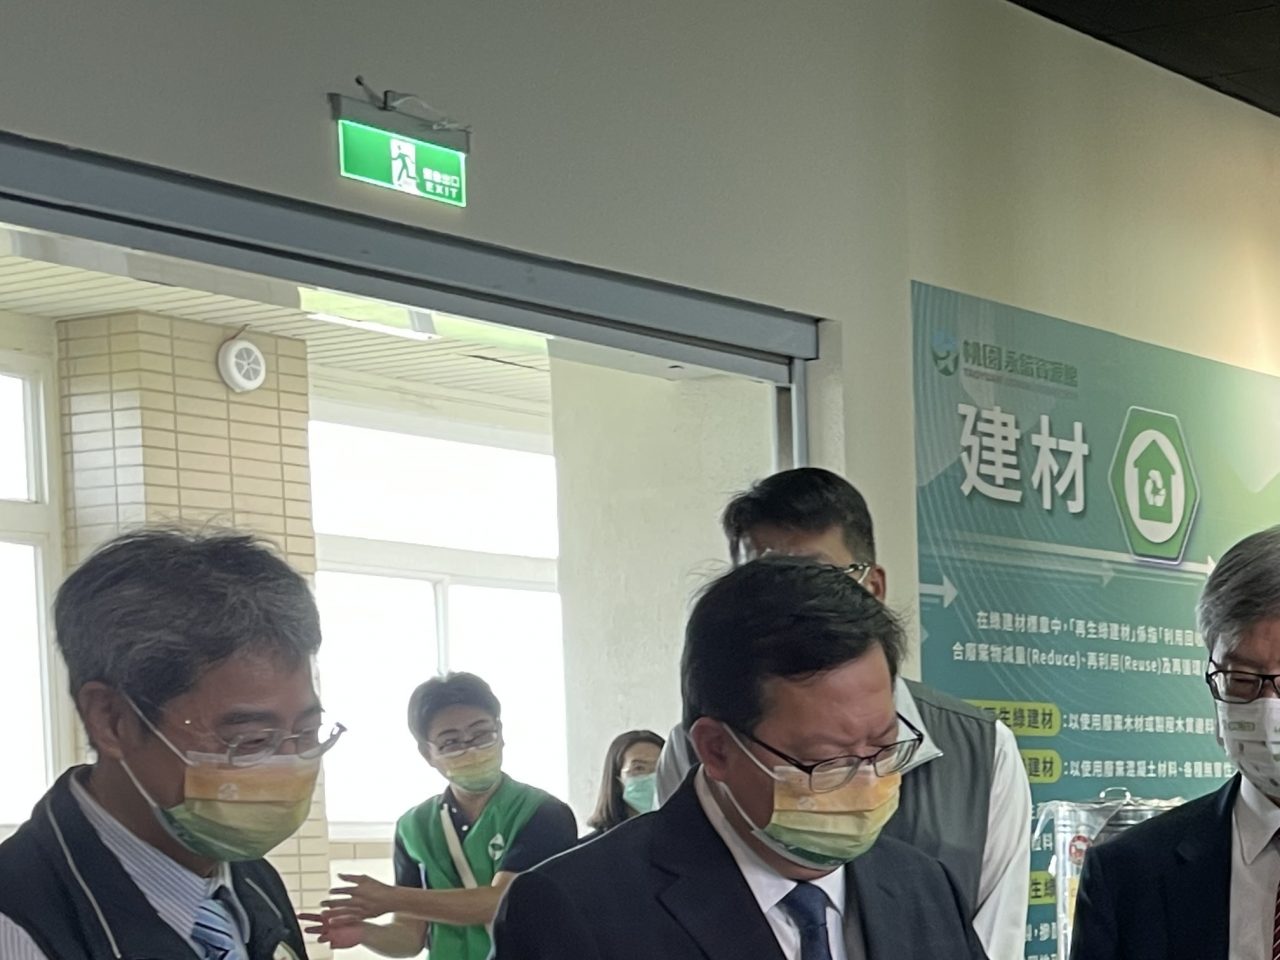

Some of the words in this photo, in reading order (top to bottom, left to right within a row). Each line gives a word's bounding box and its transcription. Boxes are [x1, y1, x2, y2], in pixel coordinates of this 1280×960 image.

[425, 180, 458, 199] EXIT
[957, 402, 1090, 514] 建材
[1023, 756, 1055, 778] 建材
